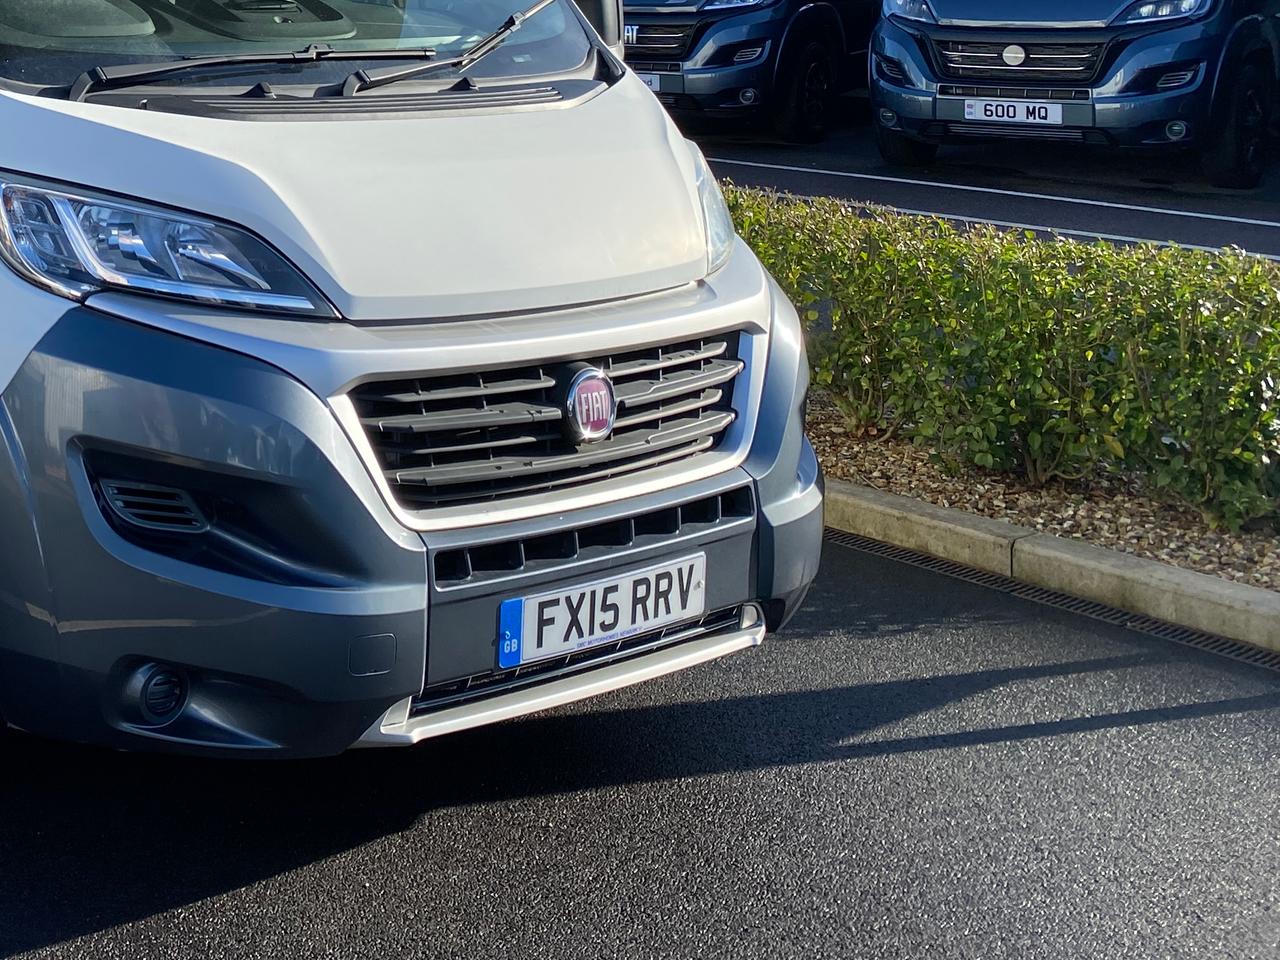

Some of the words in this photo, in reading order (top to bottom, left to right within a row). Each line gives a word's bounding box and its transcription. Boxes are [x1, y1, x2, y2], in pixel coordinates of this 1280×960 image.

[624, 25, 640, 44] AT
[983, 103, 1017, 119] 600
[1026, 105, 1048, 121] MQ
[581, 390, 608, 423] FIAT
[536, 584, 620, 650] FX15
[630, 563, 695, 626] RRV
[504, 638, 518, 654] GB
